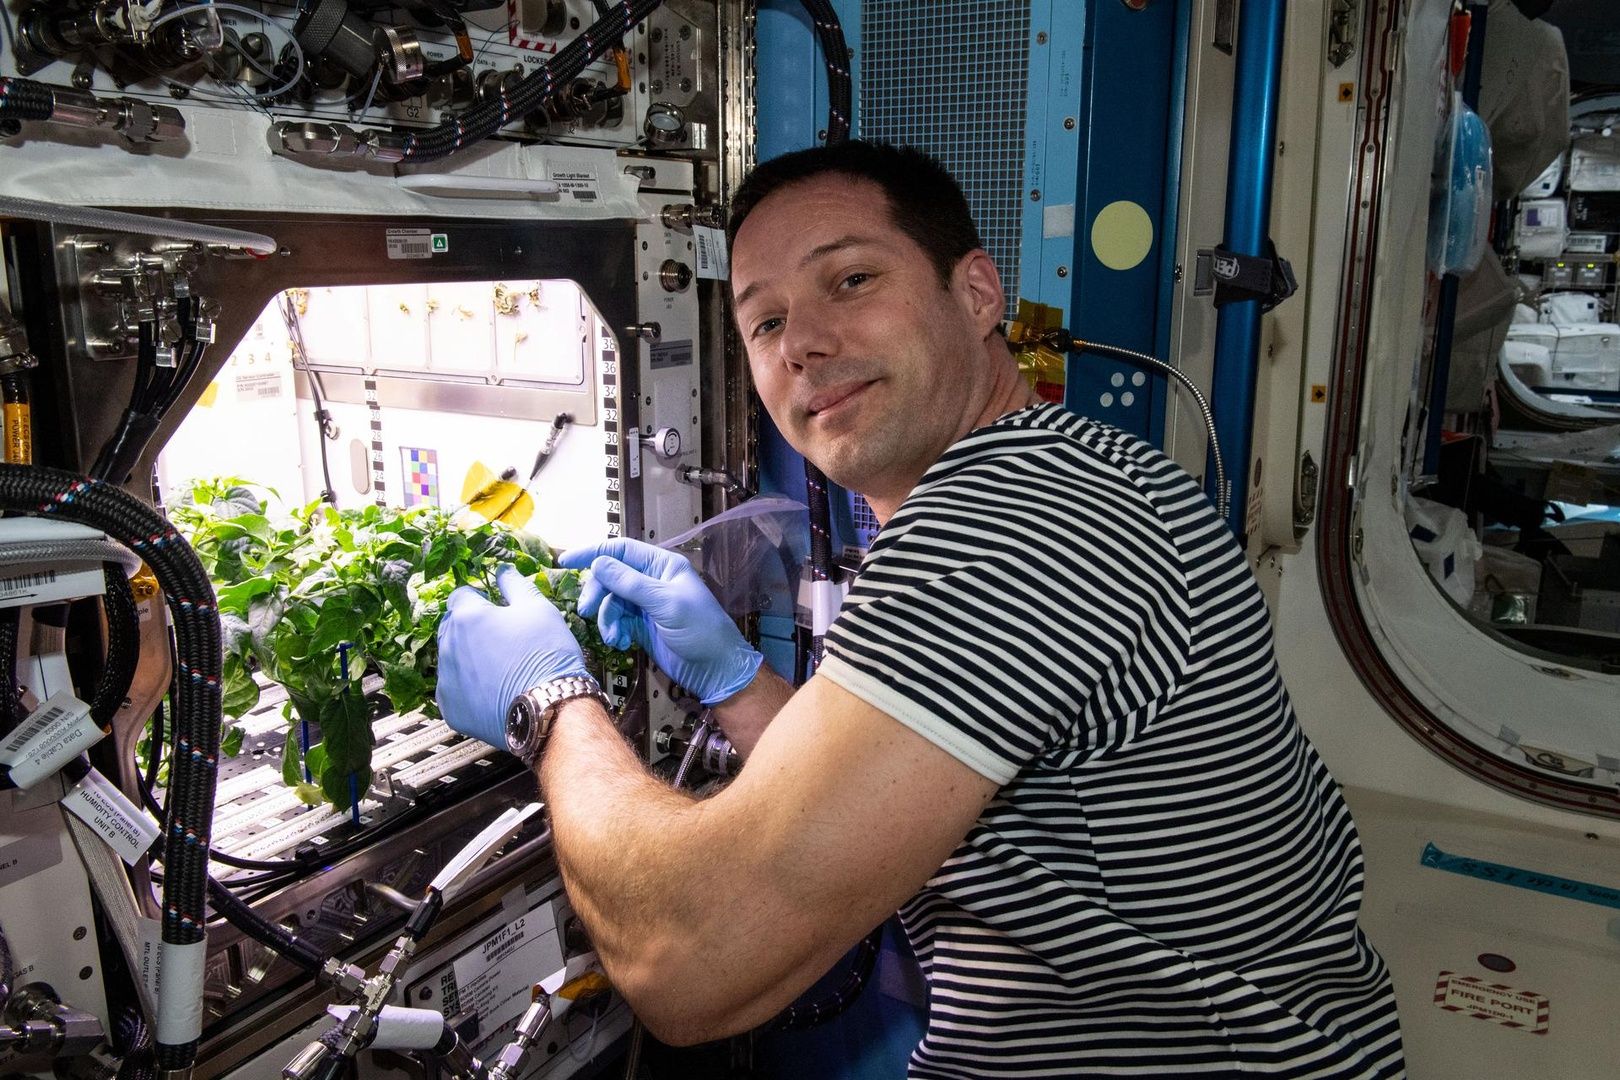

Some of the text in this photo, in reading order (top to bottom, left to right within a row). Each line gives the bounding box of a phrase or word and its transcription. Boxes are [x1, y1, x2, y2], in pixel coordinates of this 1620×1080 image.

[231, 352, 271, 366] 2 3 4
[604, 362, 616, 374] 36
[606, 410, 618, 420] 32
[606, 432, 618, 444] 30
[607, 456, 619, 467] 28
[608, 478, 620, 490] 26
[608, 501, 620, 512] 24
[609, 524, 621, 534] 22
[617, 675, 622, 686] 8
[618, 696, 624, 706] 6
[63, 728, 83, 744] Data
[40, 742, 64, 760] Cable
[80, 790, 139, 849] HUMIDITY CONTROL
[94, 816, 116, 838] UNIT B
[482, 918, 526, 954] JPM1F1_L2
[1451, 979, 1536, 1004] EMERGENCY USE
[1451, 988, 1534, 1016] FIRE PORT
